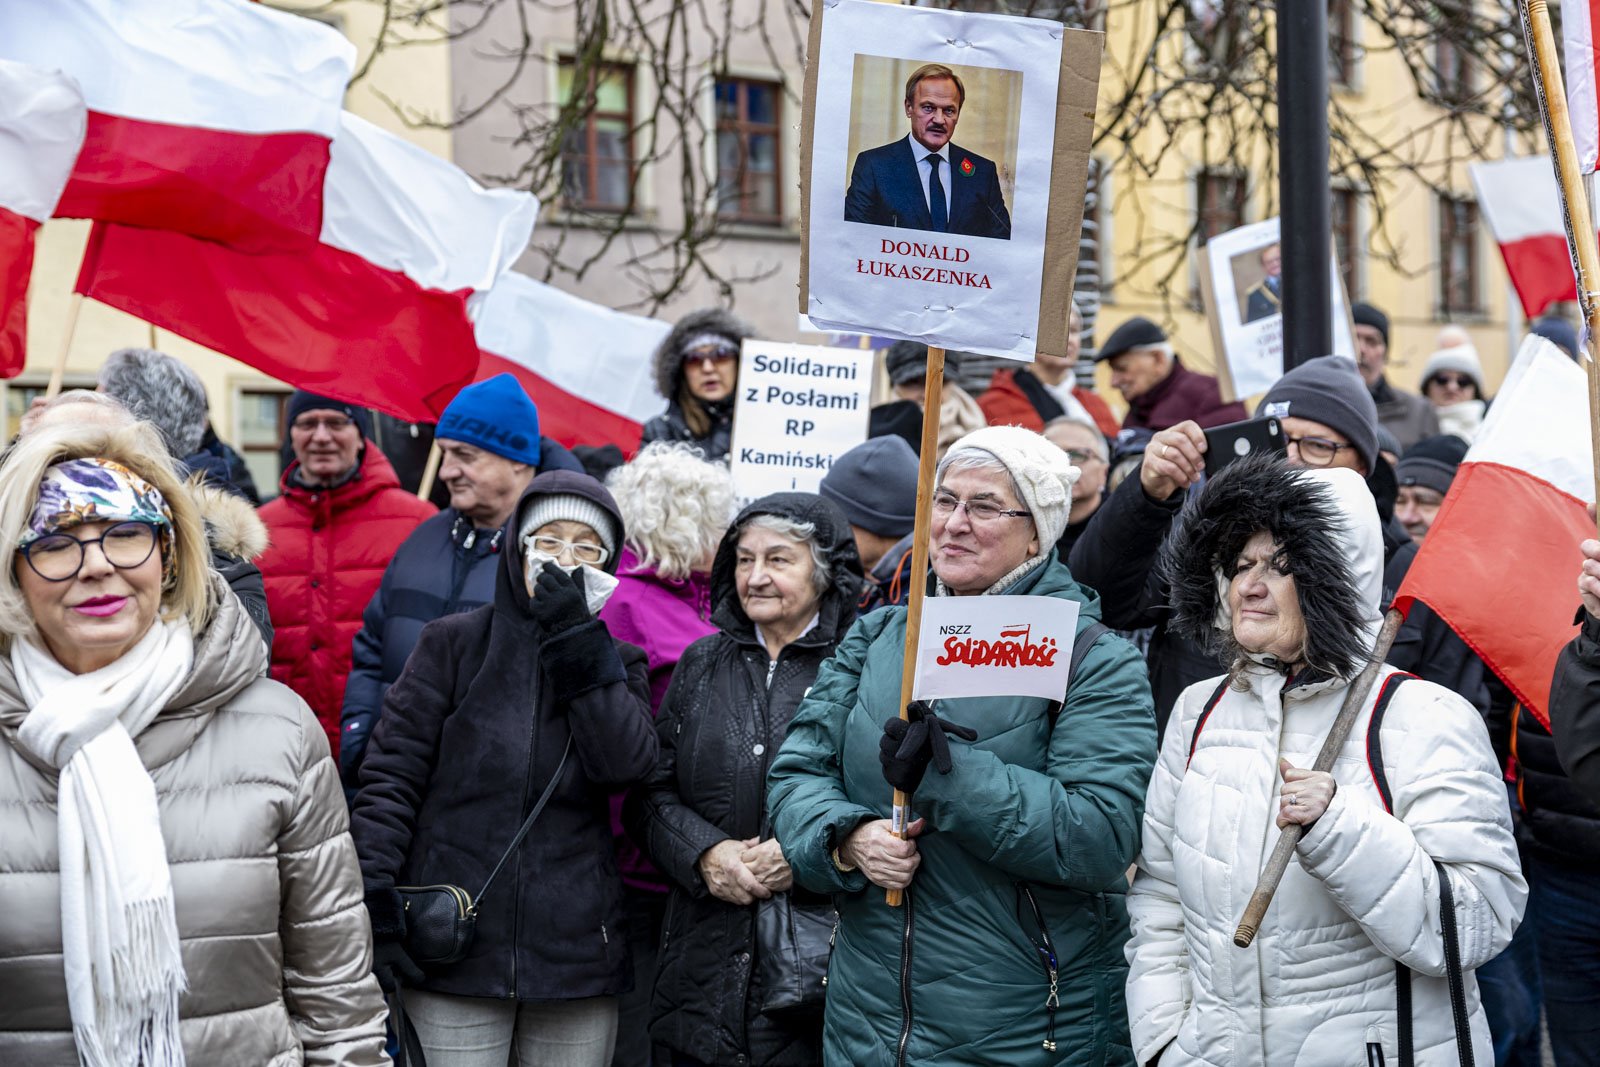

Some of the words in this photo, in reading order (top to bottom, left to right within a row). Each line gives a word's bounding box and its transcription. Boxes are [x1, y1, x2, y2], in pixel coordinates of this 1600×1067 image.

[880, 238, 970, 263] DONALD
[856, 259, 992, 290] ŁUKASZENKA
[753, 354, 857, 380] Solidarni
[746, 388, 759, 402] z
[766, 385, 859, 410] Posłami
[785, 419, 815, 437] RP
[740, 447, 833, 470] Kamiński
[791, 477, 796, 490] i
[939, 624, 972, 636] NSZZ
